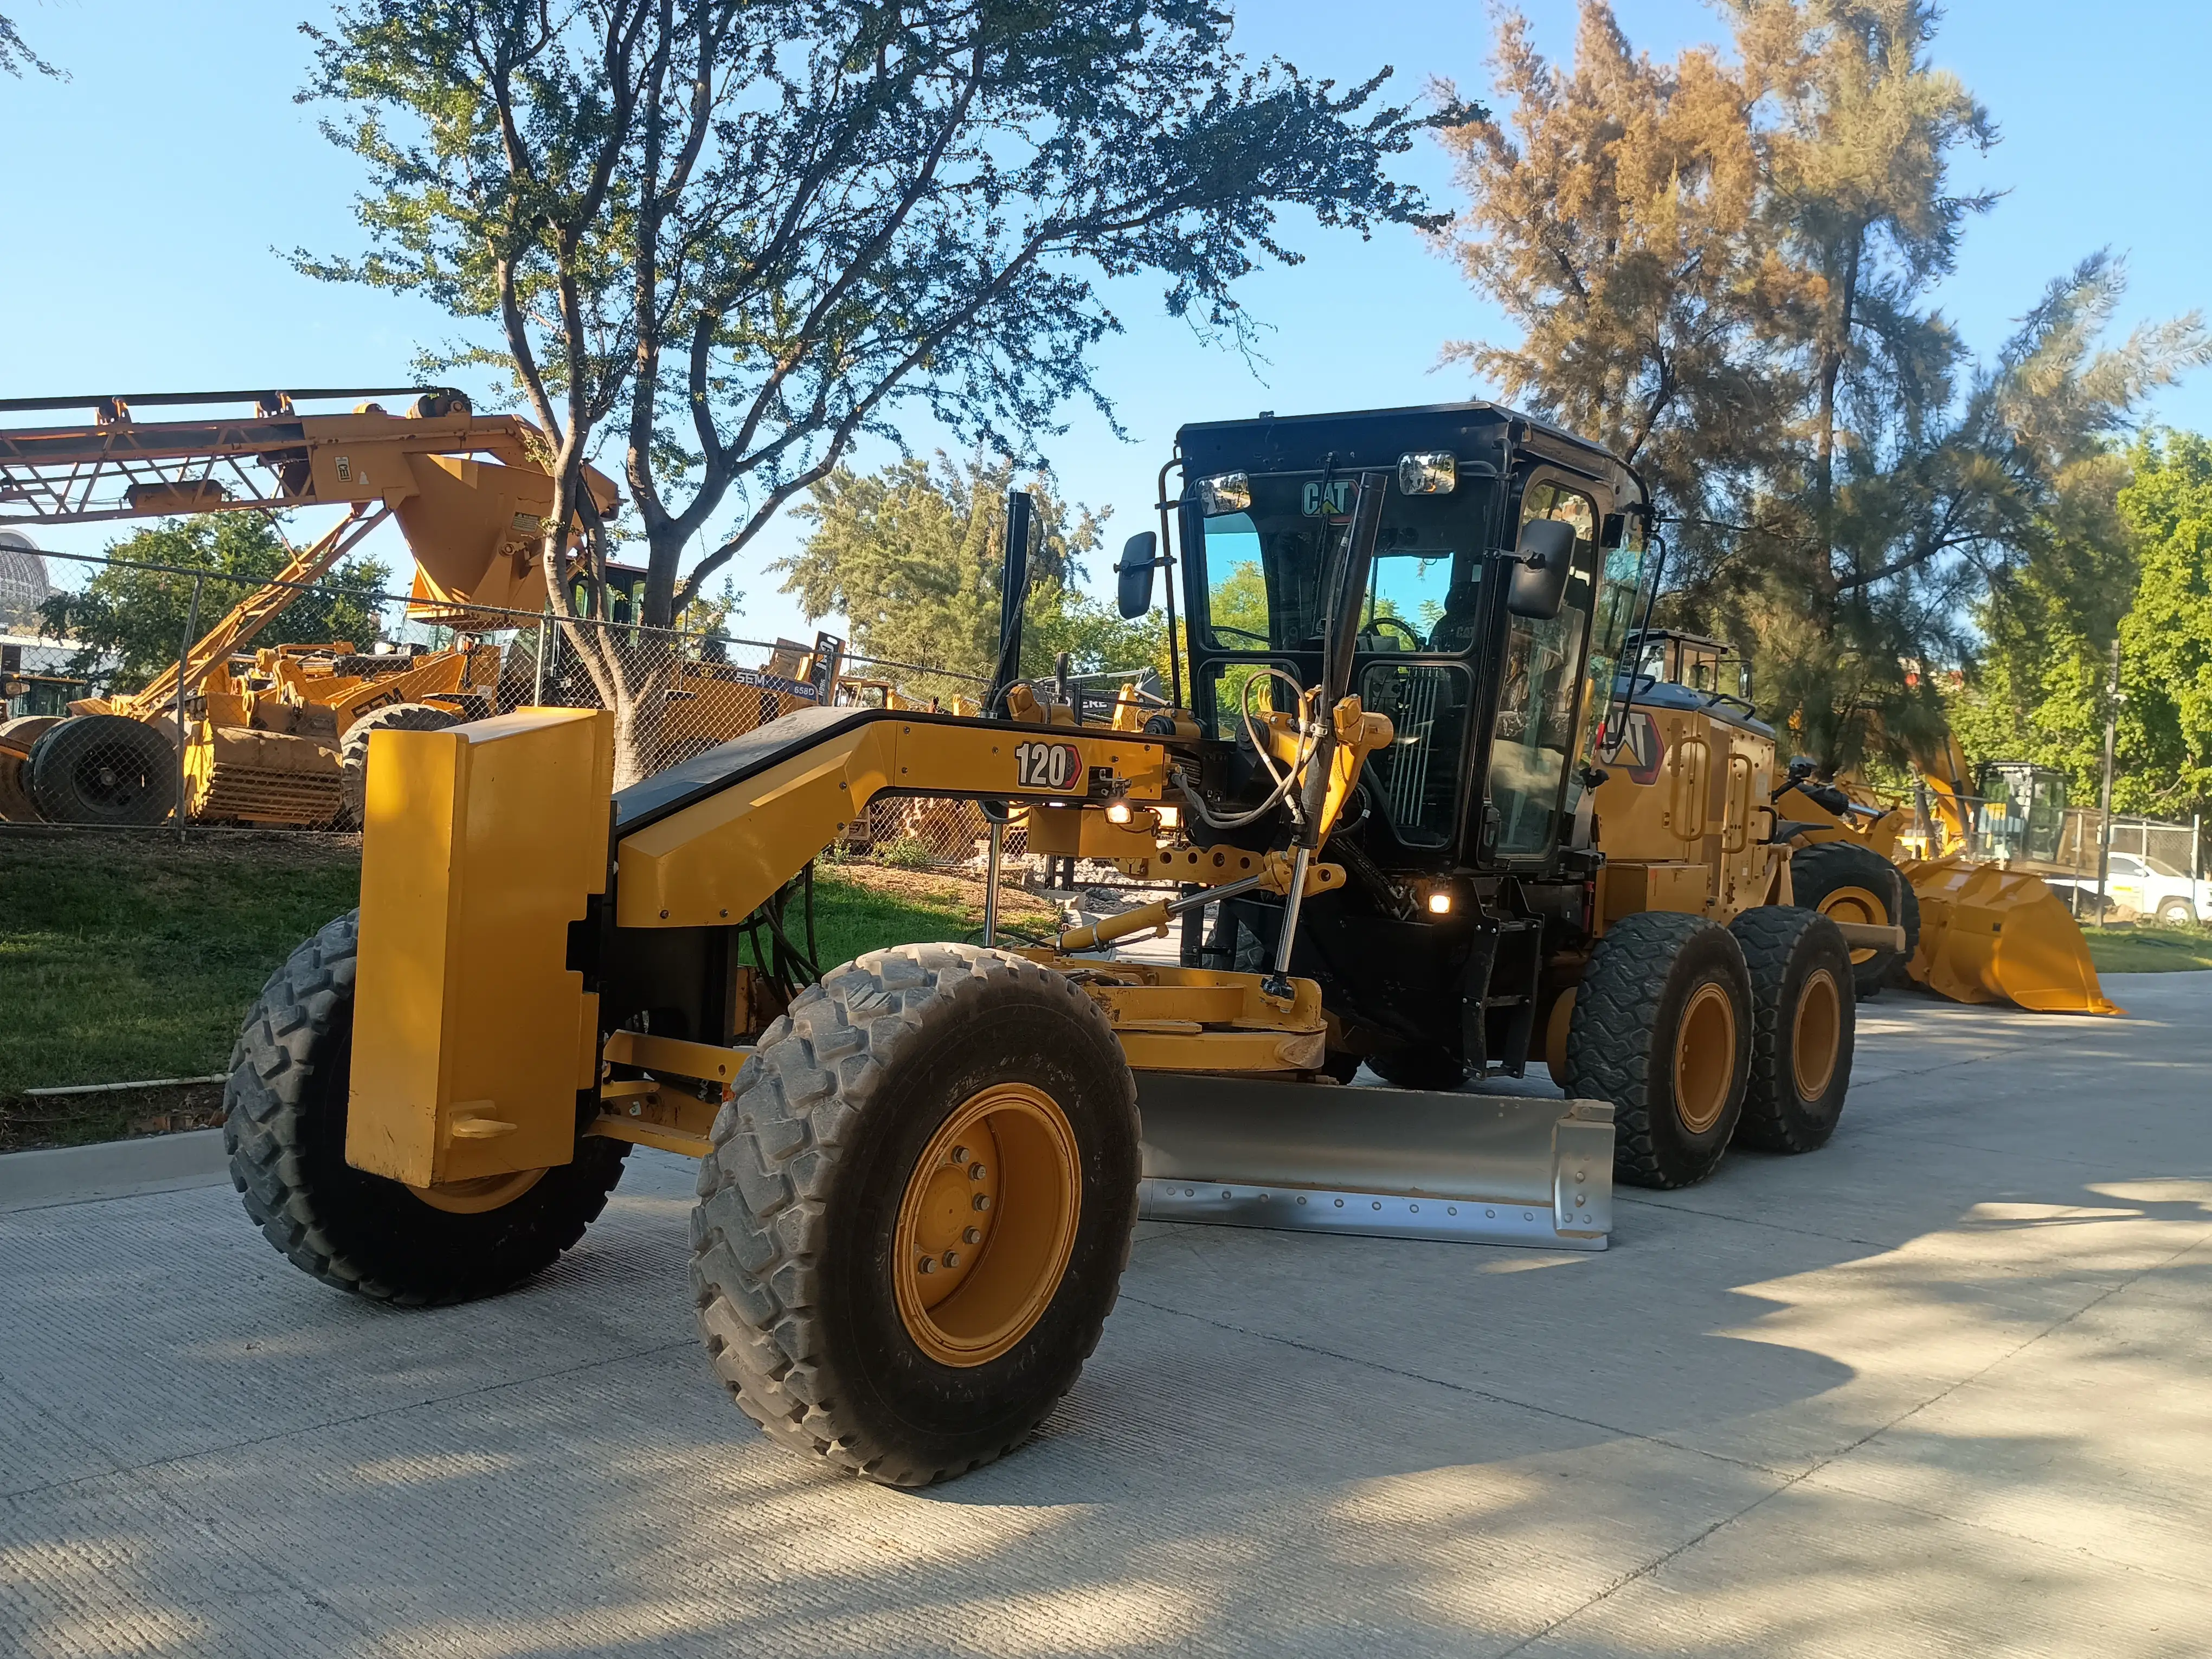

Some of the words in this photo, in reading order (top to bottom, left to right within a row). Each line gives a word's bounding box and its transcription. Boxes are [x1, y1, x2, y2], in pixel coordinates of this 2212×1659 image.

[1304, 481, 1349, 515] CAT
[736, 672, 765, 685] SEM
[794, 686, 814, 696] 658D
[1065, 696, 1108, 709] DERE
[1600, 711, 1646, 767] CAT
[1016, 743, 1066, 787] 120
